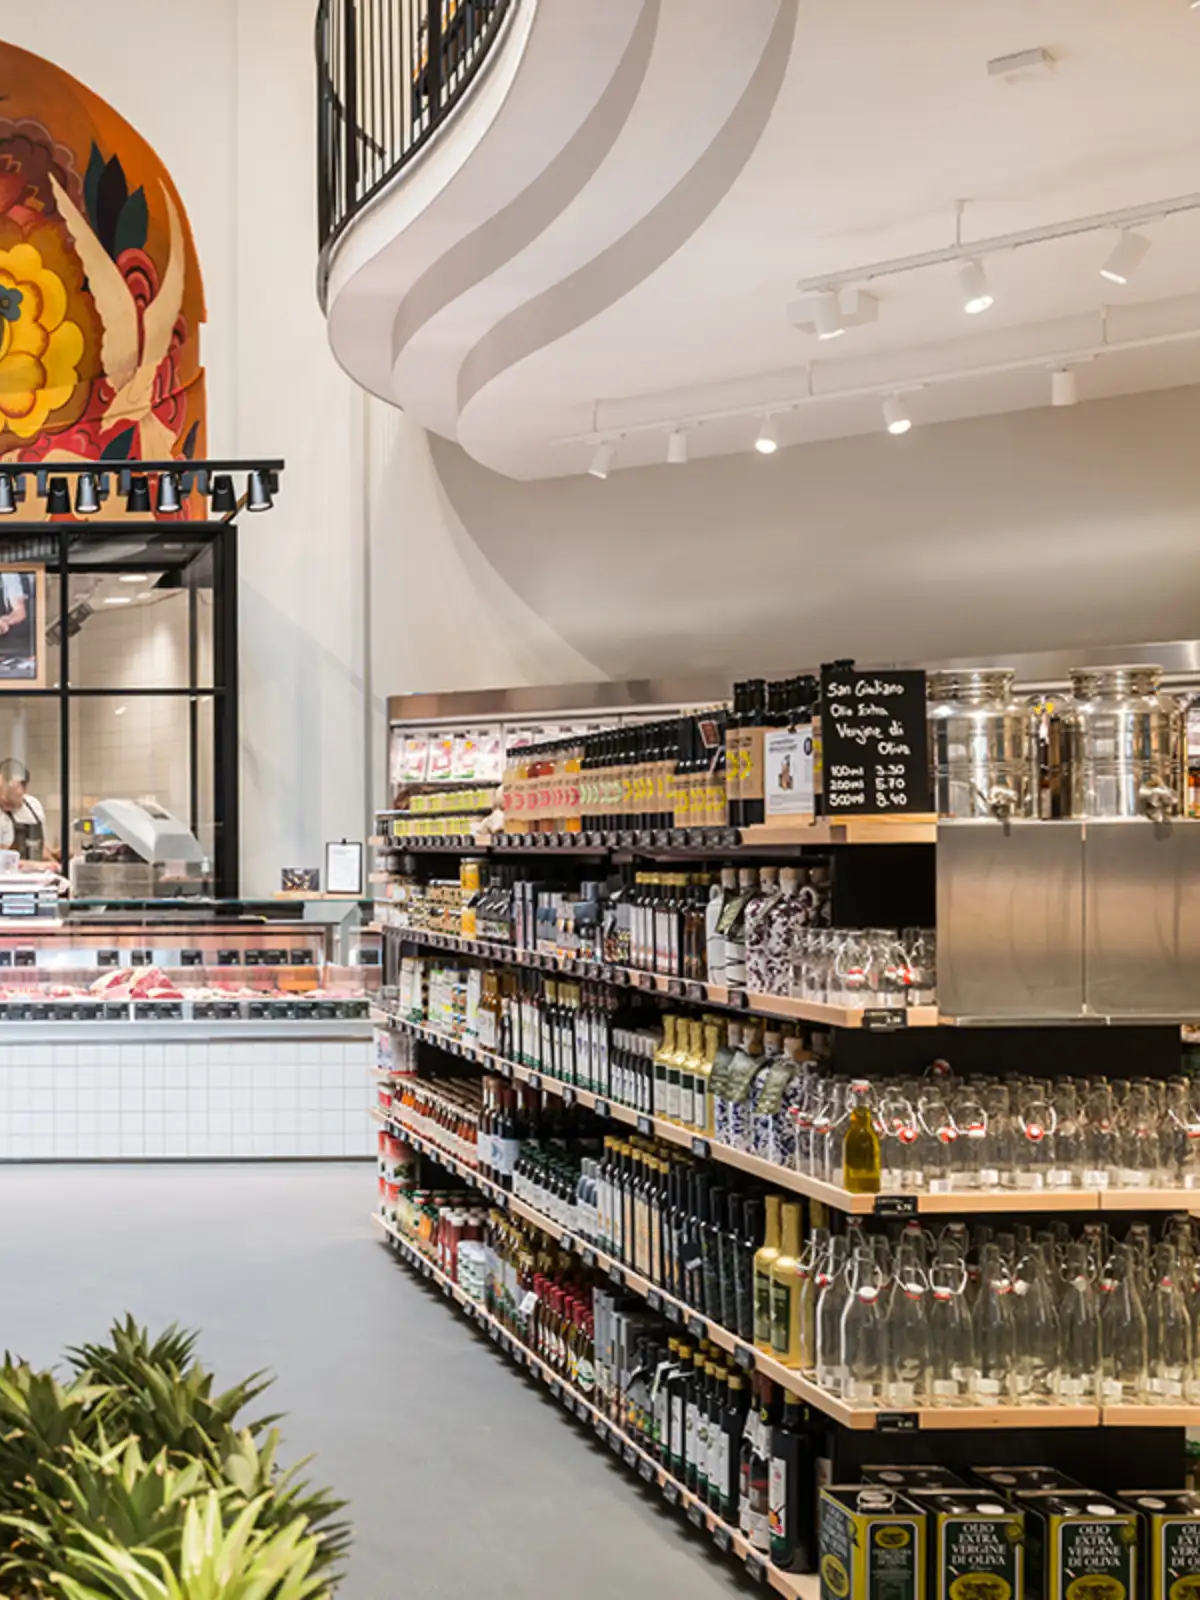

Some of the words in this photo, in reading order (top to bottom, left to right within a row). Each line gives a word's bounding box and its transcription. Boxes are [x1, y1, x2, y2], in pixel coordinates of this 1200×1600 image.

[826, 682, 852, 697] San
[857, 702, 889, 717] Extra
[888, 719, 904, 736] di
[962, 1523, 995, 1534] OLIO
[1078, 1525, 1110, 1535] OLIO
[958, 1533, 1000, 1545] EXTRA
[1075, 1535, 1114, 1546] EXTRA
[951, 1544, 1007, 1555] VERGINE
[1067, 1545, 1121, 1556] VERGINE
[951, 1554, 966, 1565] DI
[968, 1554, 1007, 1566] OLIVA
[1067, 1556, 1082, 1567] DI
[1084, 1556, 1121, 1567] OLIVA
